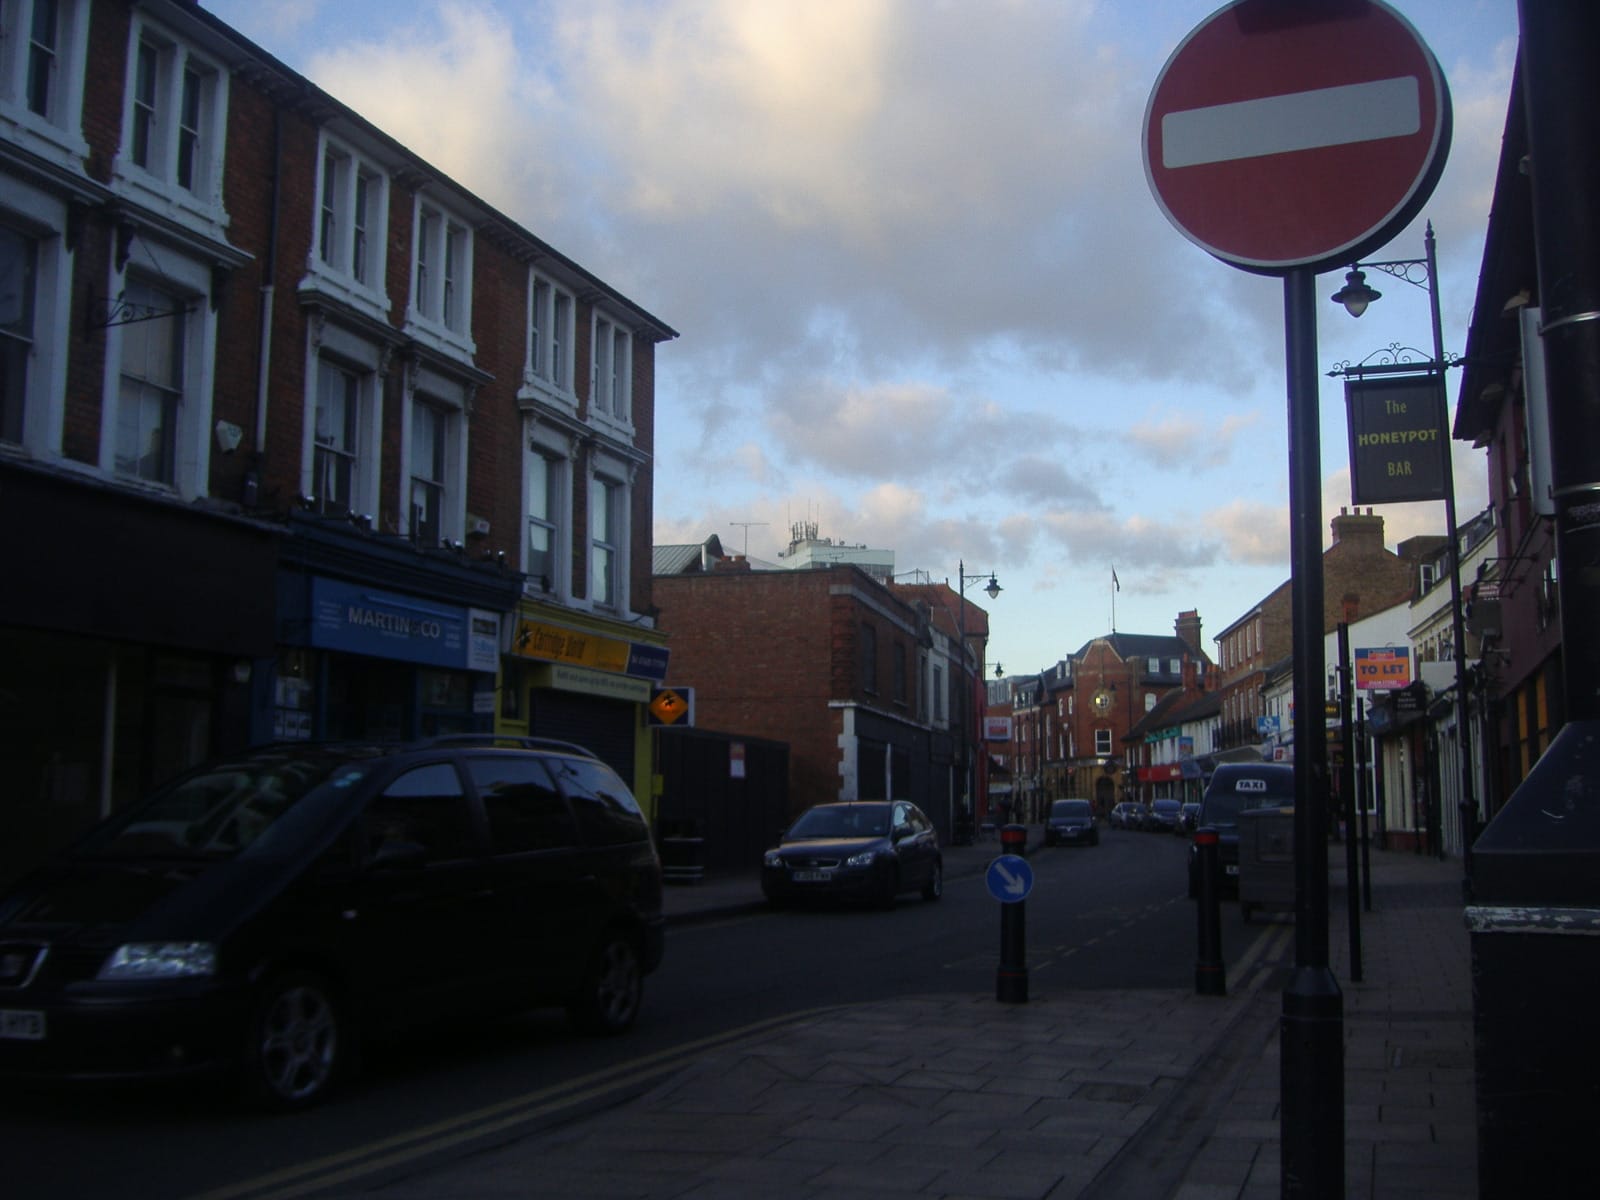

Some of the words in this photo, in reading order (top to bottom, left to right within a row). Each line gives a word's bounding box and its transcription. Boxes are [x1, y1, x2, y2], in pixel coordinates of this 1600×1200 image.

[1384, 400, 1407, 415] The
[1358, 429, 1438, 447] HONEYPOT
[1387, 460, 1413, 477] BAR
[1360, 665, 1378, 675] TO
[1383, 664, 1404, 675] LET
[1239, 781, 1264, 789] TAXI
